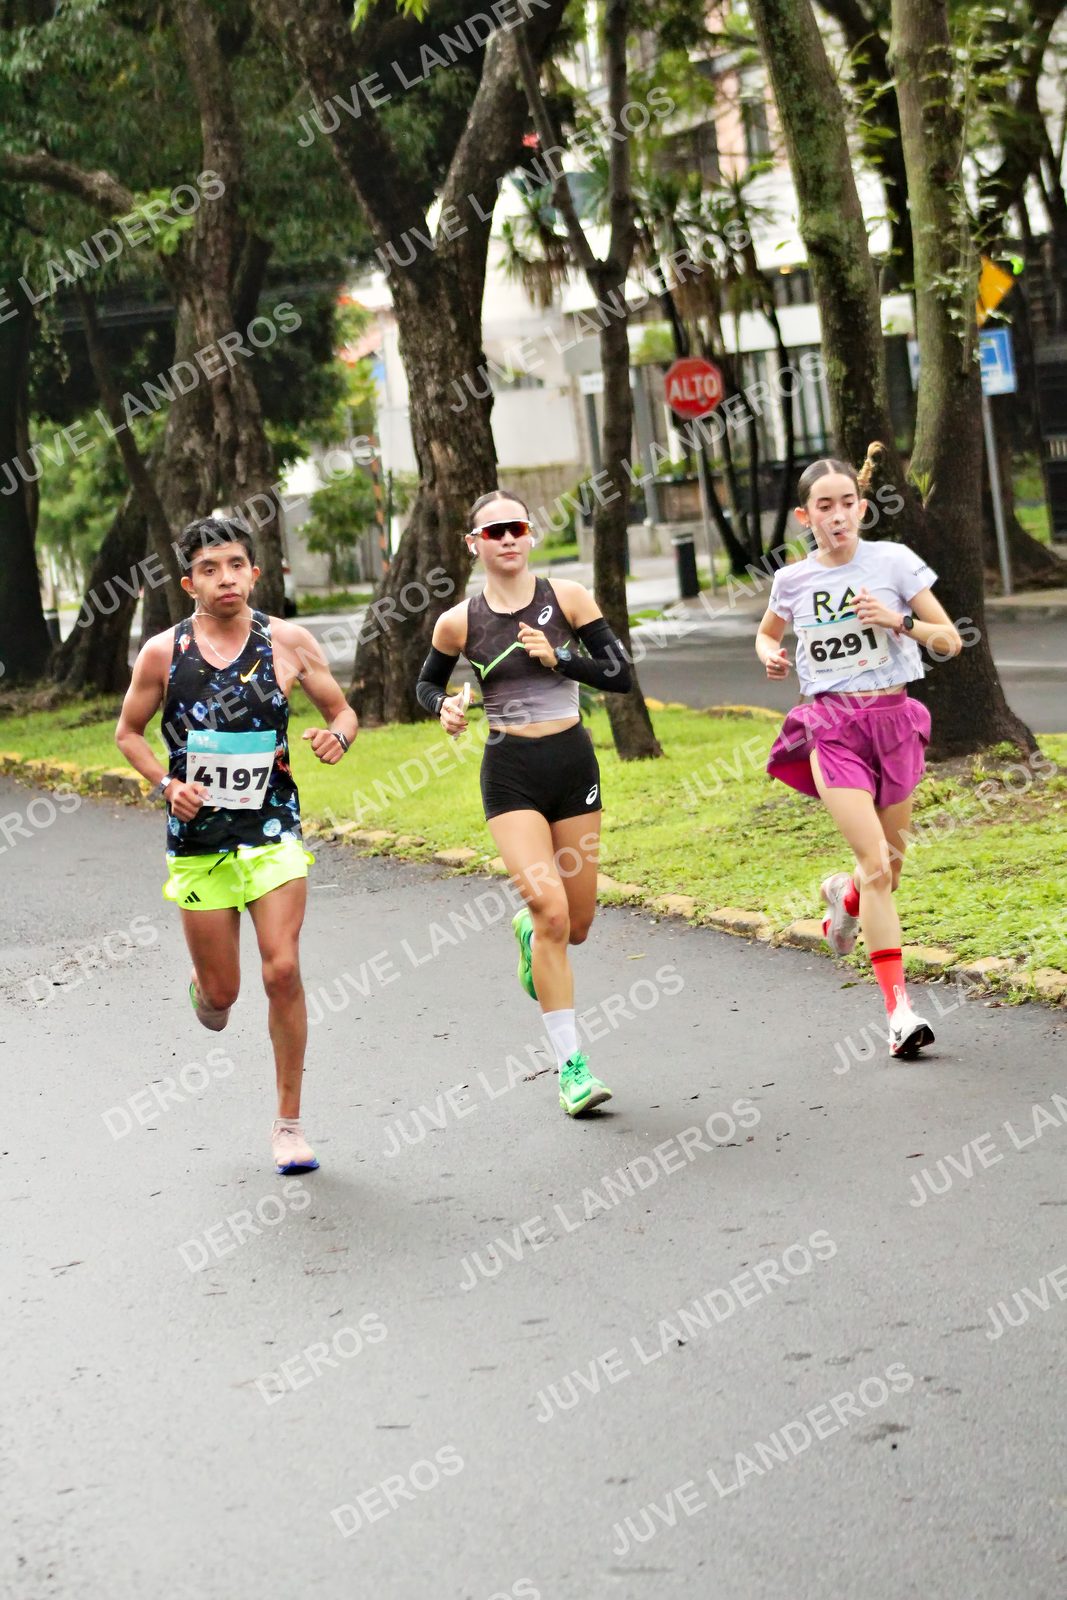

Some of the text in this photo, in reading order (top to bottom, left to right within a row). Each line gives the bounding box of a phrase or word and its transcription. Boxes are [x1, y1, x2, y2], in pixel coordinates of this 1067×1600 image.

[669, 373, 718, 401] ALTO
[810, 627, 878, 662] 6291
[193, 766, 270, 791] 4197
